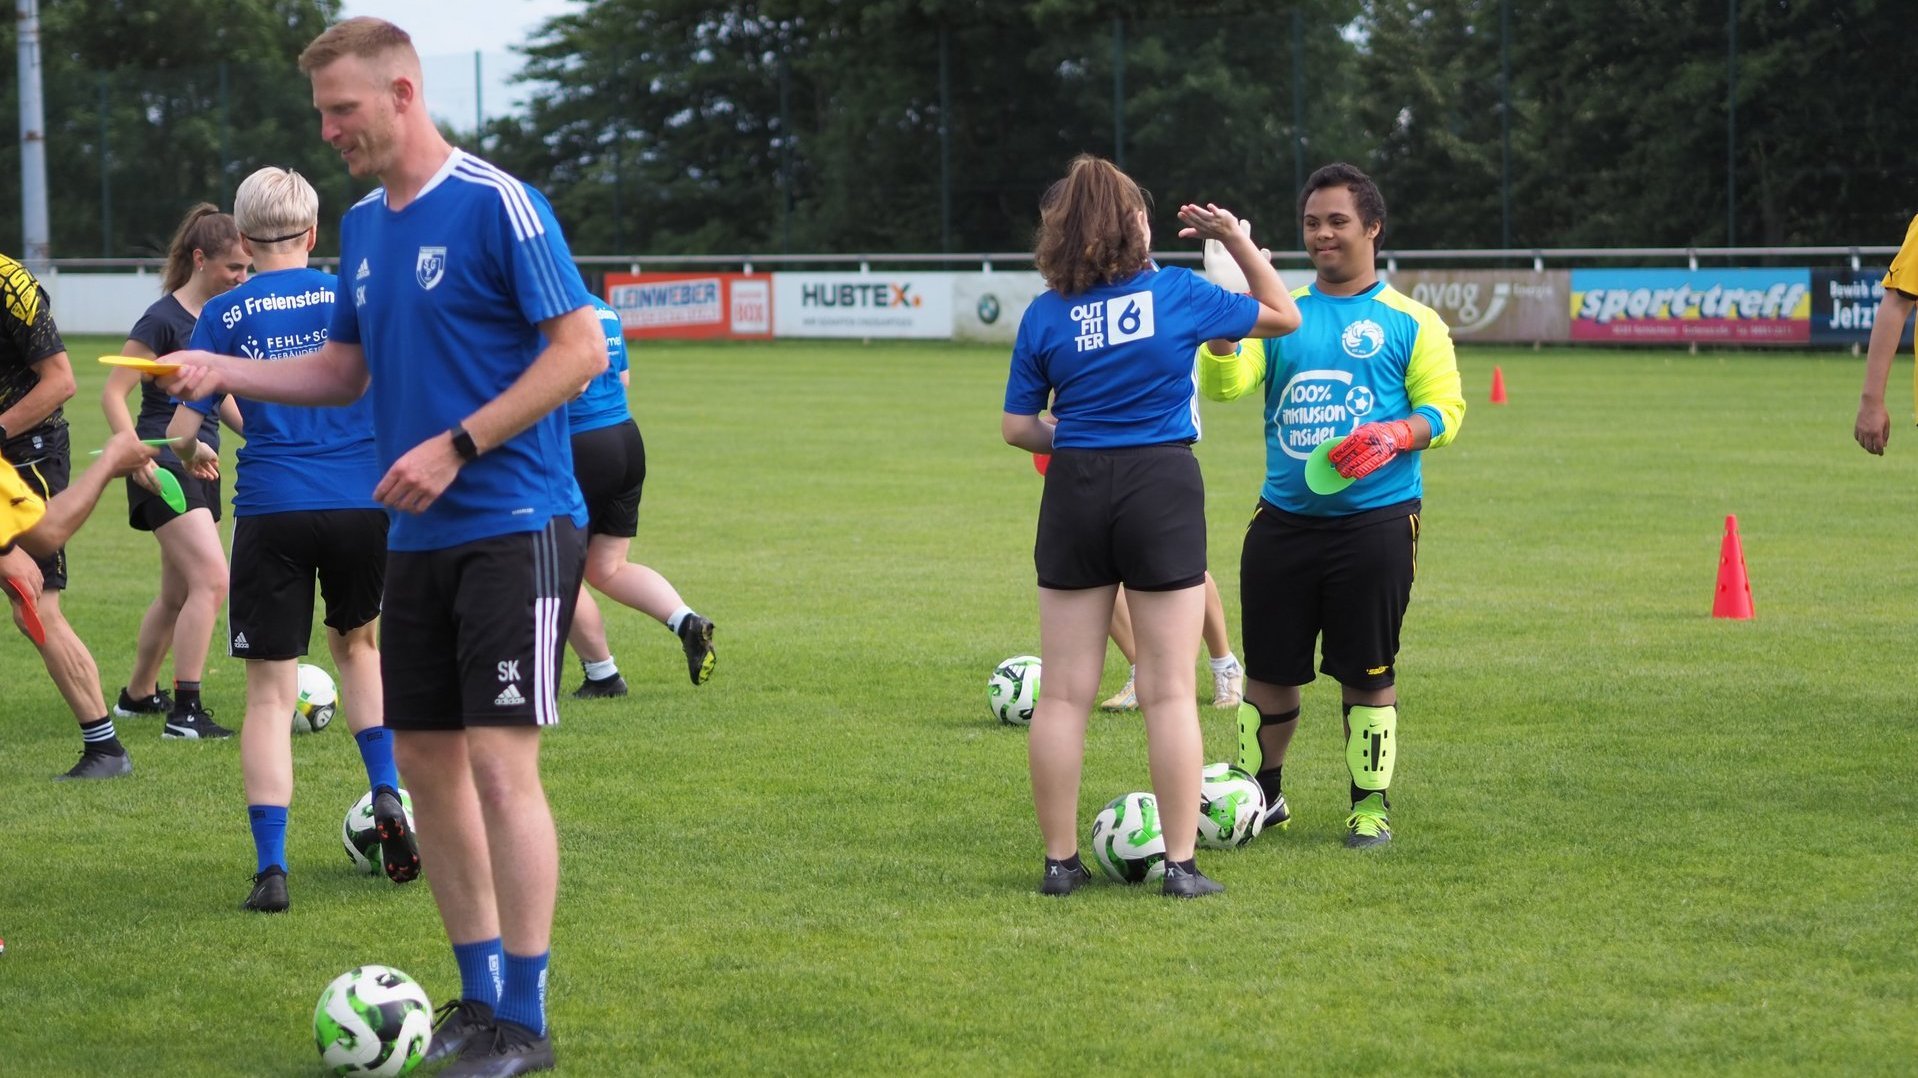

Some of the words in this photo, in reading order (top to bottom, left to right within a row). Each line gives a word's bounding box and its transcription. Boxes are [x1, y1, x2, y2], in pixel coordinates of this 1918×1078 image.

[613, 283, 716, 309] LEINWEBER
[1412, 282, 1479, 324] ovag
[1580, 282, 1807, 323] sport-treff
[222, 305, 243, 330] SG
[245, 286, 336, 315] Freienstein
[1070, 301, 1104, 321] OUT
[1081, 316, 1104, 335] FIT
[1075, 333, 1104, 352] TER
[1290, 384, 1333, 404] 100%
[1282, 404, 1346, 425] inklusion
[497, 660, 521, 682] SK
